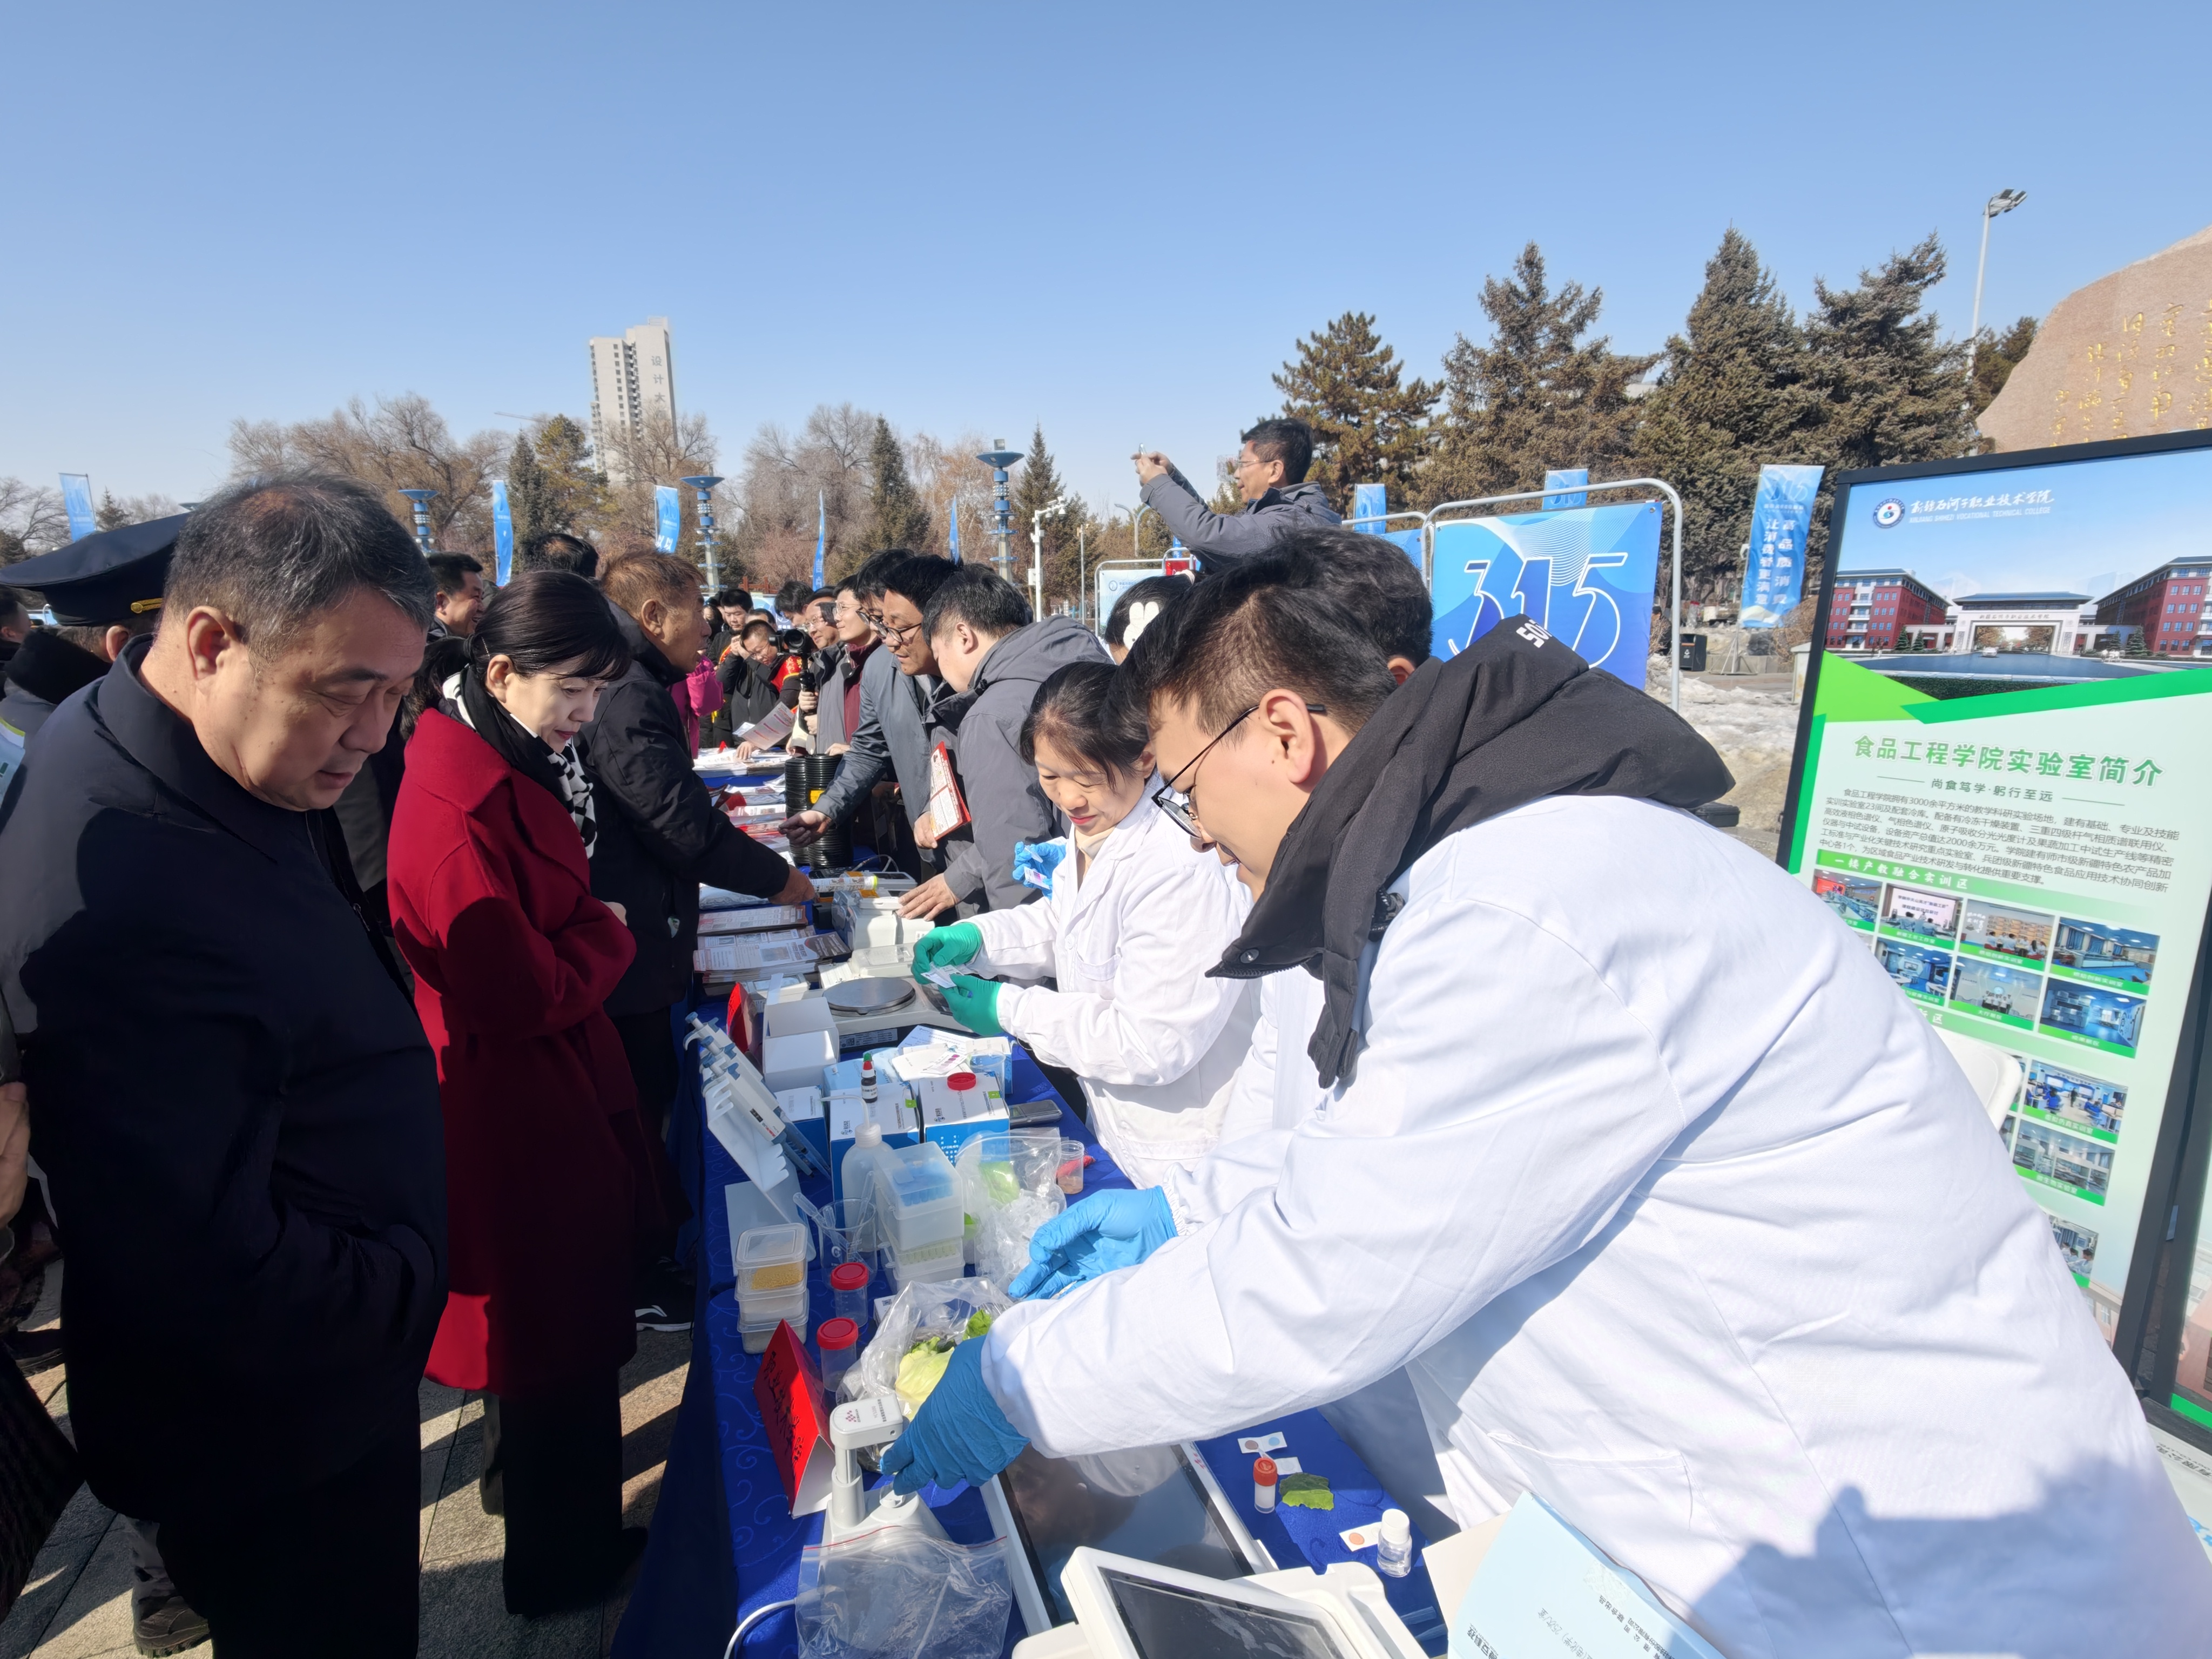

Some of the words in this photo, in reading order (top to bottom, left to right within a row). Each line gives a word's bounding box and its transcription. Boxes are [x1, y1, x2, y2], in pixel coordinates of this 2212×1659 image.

[1908, 515, 1933, 523] XINJIANG
[1934, 512, 1955, 522] SHIHEZI
[1957, 511, 1991, 520] VOCATIONAL
[1993, 509, 2022, 518] TECHNICAL
[2025, 507, 2051, 515] COLLEGE
[1910, 489, 2055, 514] 新疆石河子职业技术学院
[1755, 518, 1779, 605] 让消费者更满意
[1772, 519, 1796, 605] 高品质消费
[1448, 551, 1629, 670] 315
[1853, 734, 2164, 786] 食品工程学院实验室简介
[1931, 778, 2053, 802] 尚食笃学·躬行至远
[1834, 858, 1968, 889] 一楼产教融合实训区
[1599, 1595, 1625, 1623] 联合出品
